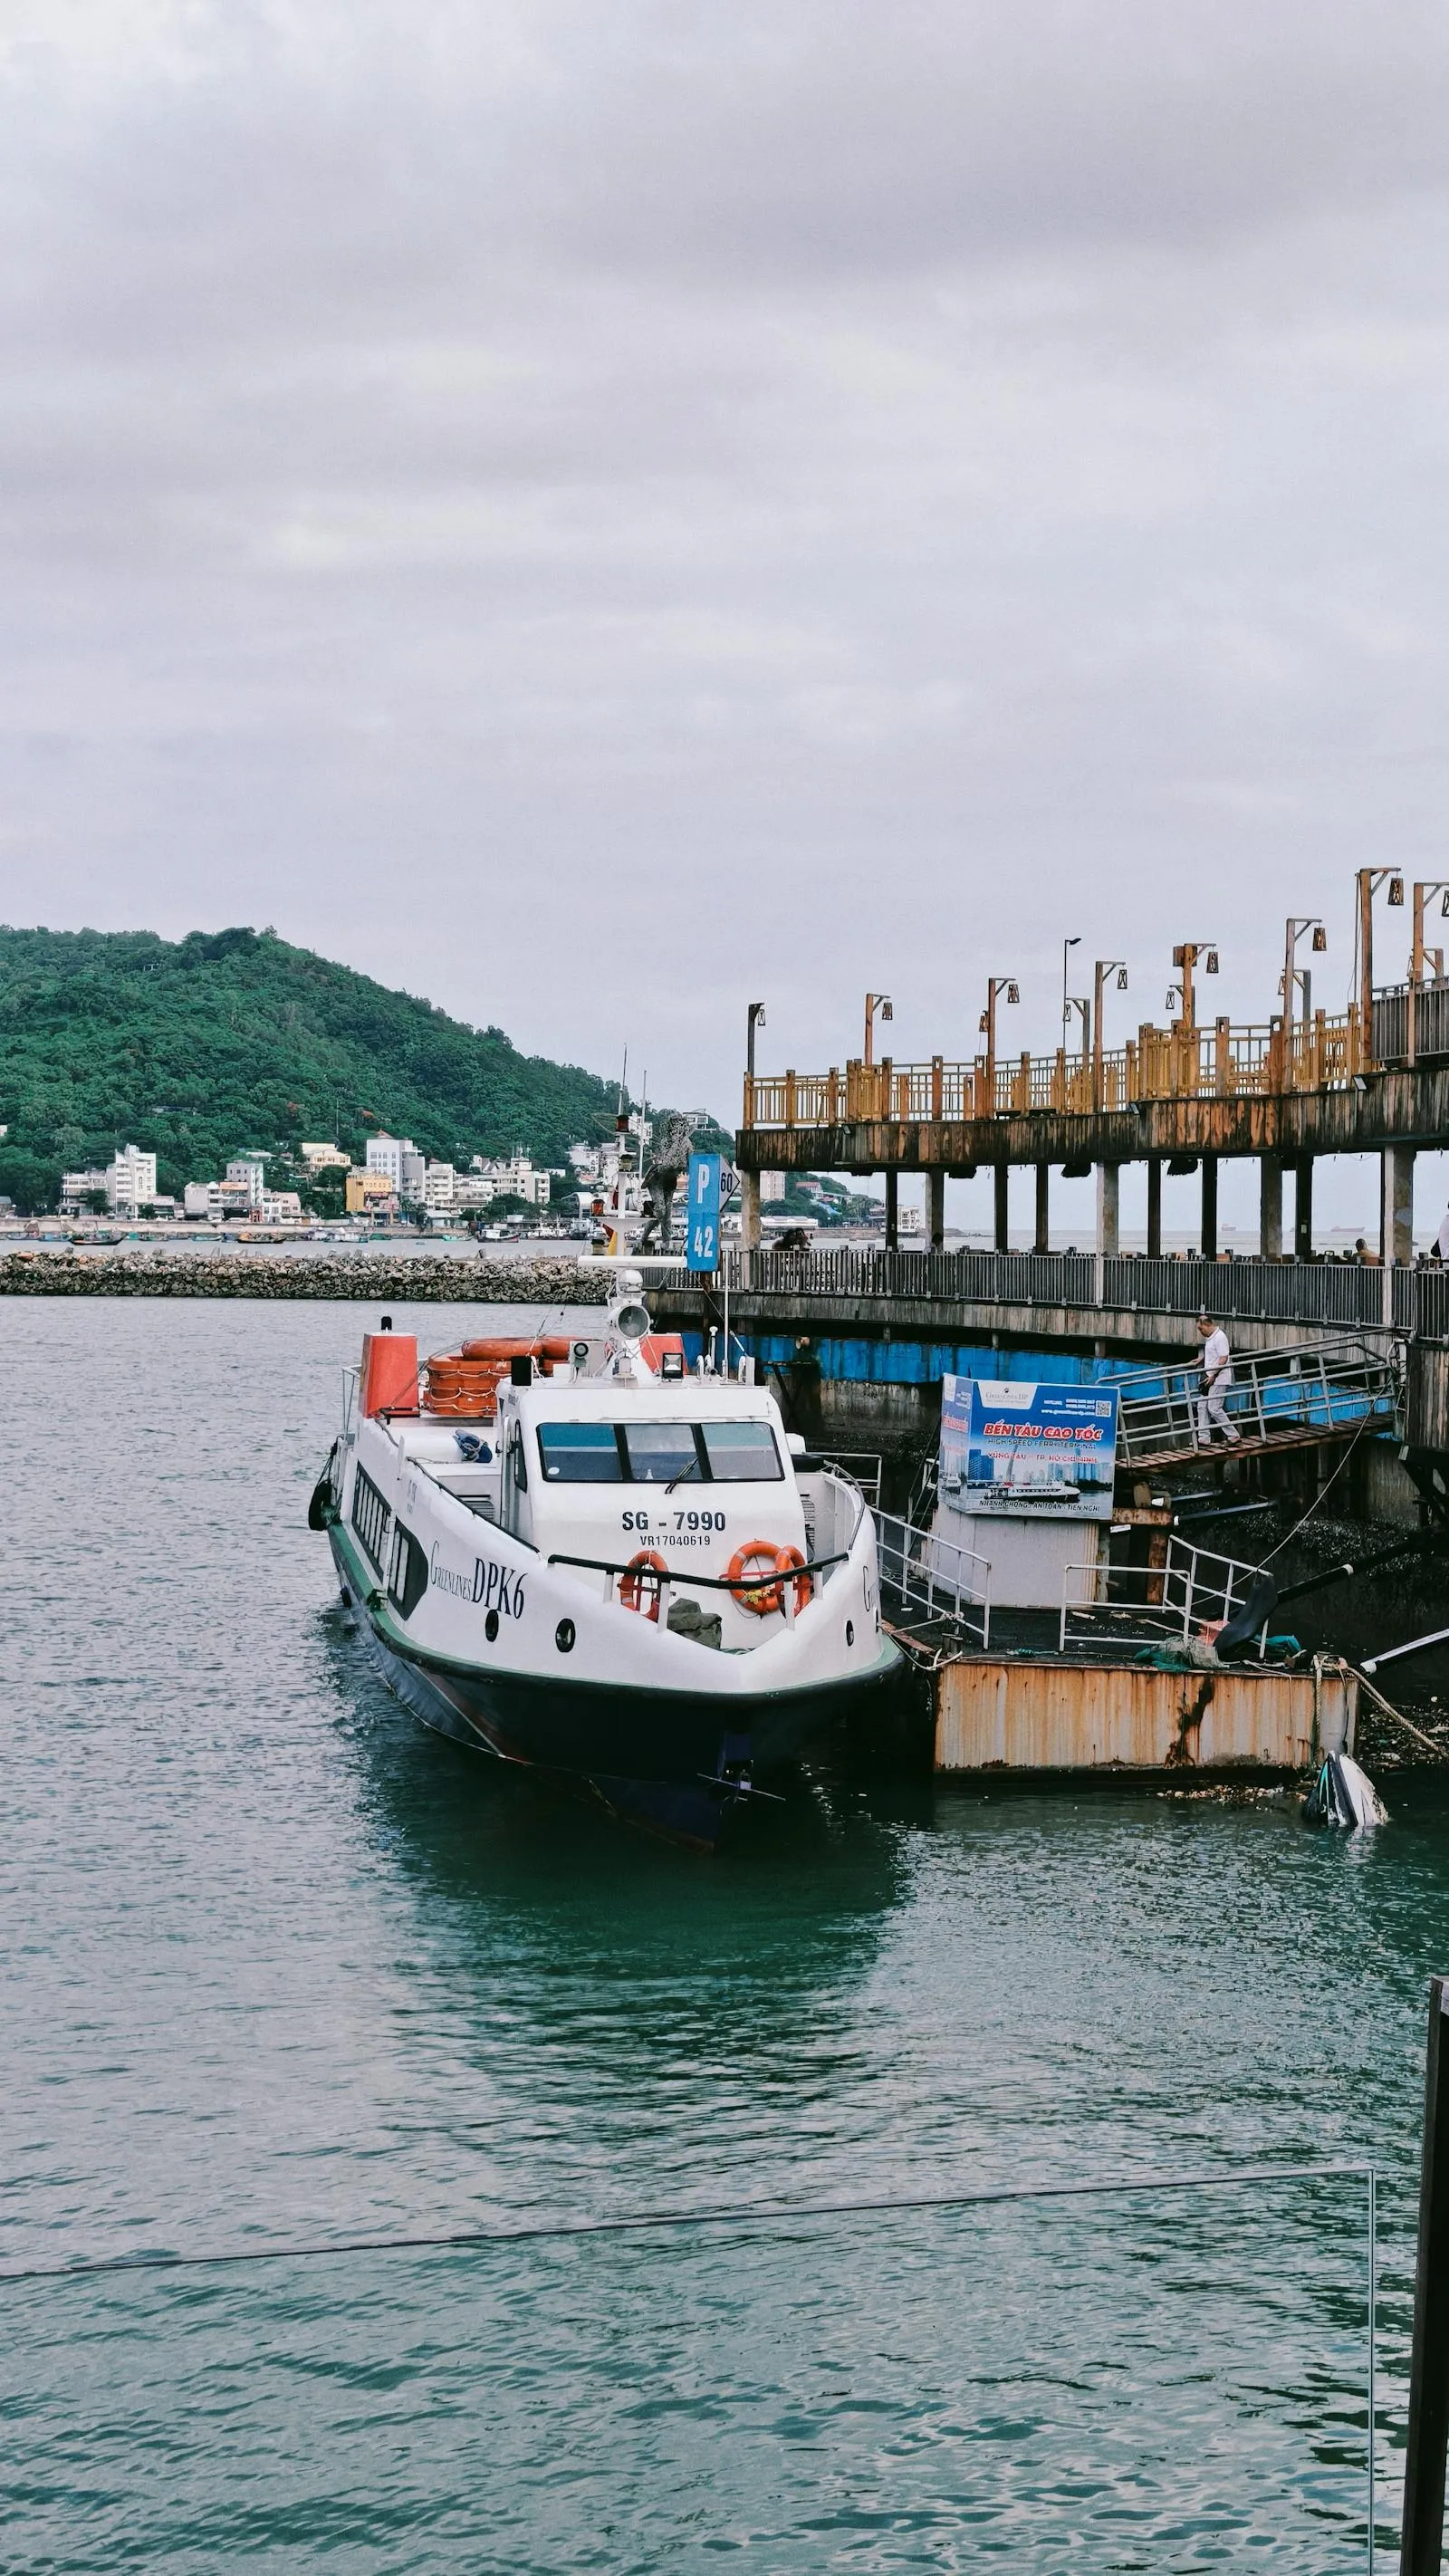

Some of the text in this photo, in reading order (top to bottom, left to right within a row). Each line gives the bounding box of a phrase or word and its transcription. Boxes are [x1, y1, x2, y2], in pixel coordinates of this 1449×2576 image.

[697, 1164, 710, 1204] P
[720, 1172, 733, 1193] 60
[694, 1226, 714, 1258] 42
[984, 1419, 1013, 1437] BẾN
[1043, 1426, 1073, 1439] CAO
[1075, 1423, 1104, 1441] TỐC
[1008, 1438, 1033, 1447] SPEED
[1034, 1440, 1058, 1448] FERRY
[1060, 1441, 1097, 1449] TERMINAL
[622, 1512, 648, 1531] SG
[673, 1512, 725, 1531] 7990
[639, 1535, 711, 1546] VR17040619
[471, 1557, 528, 1620] DPK6
